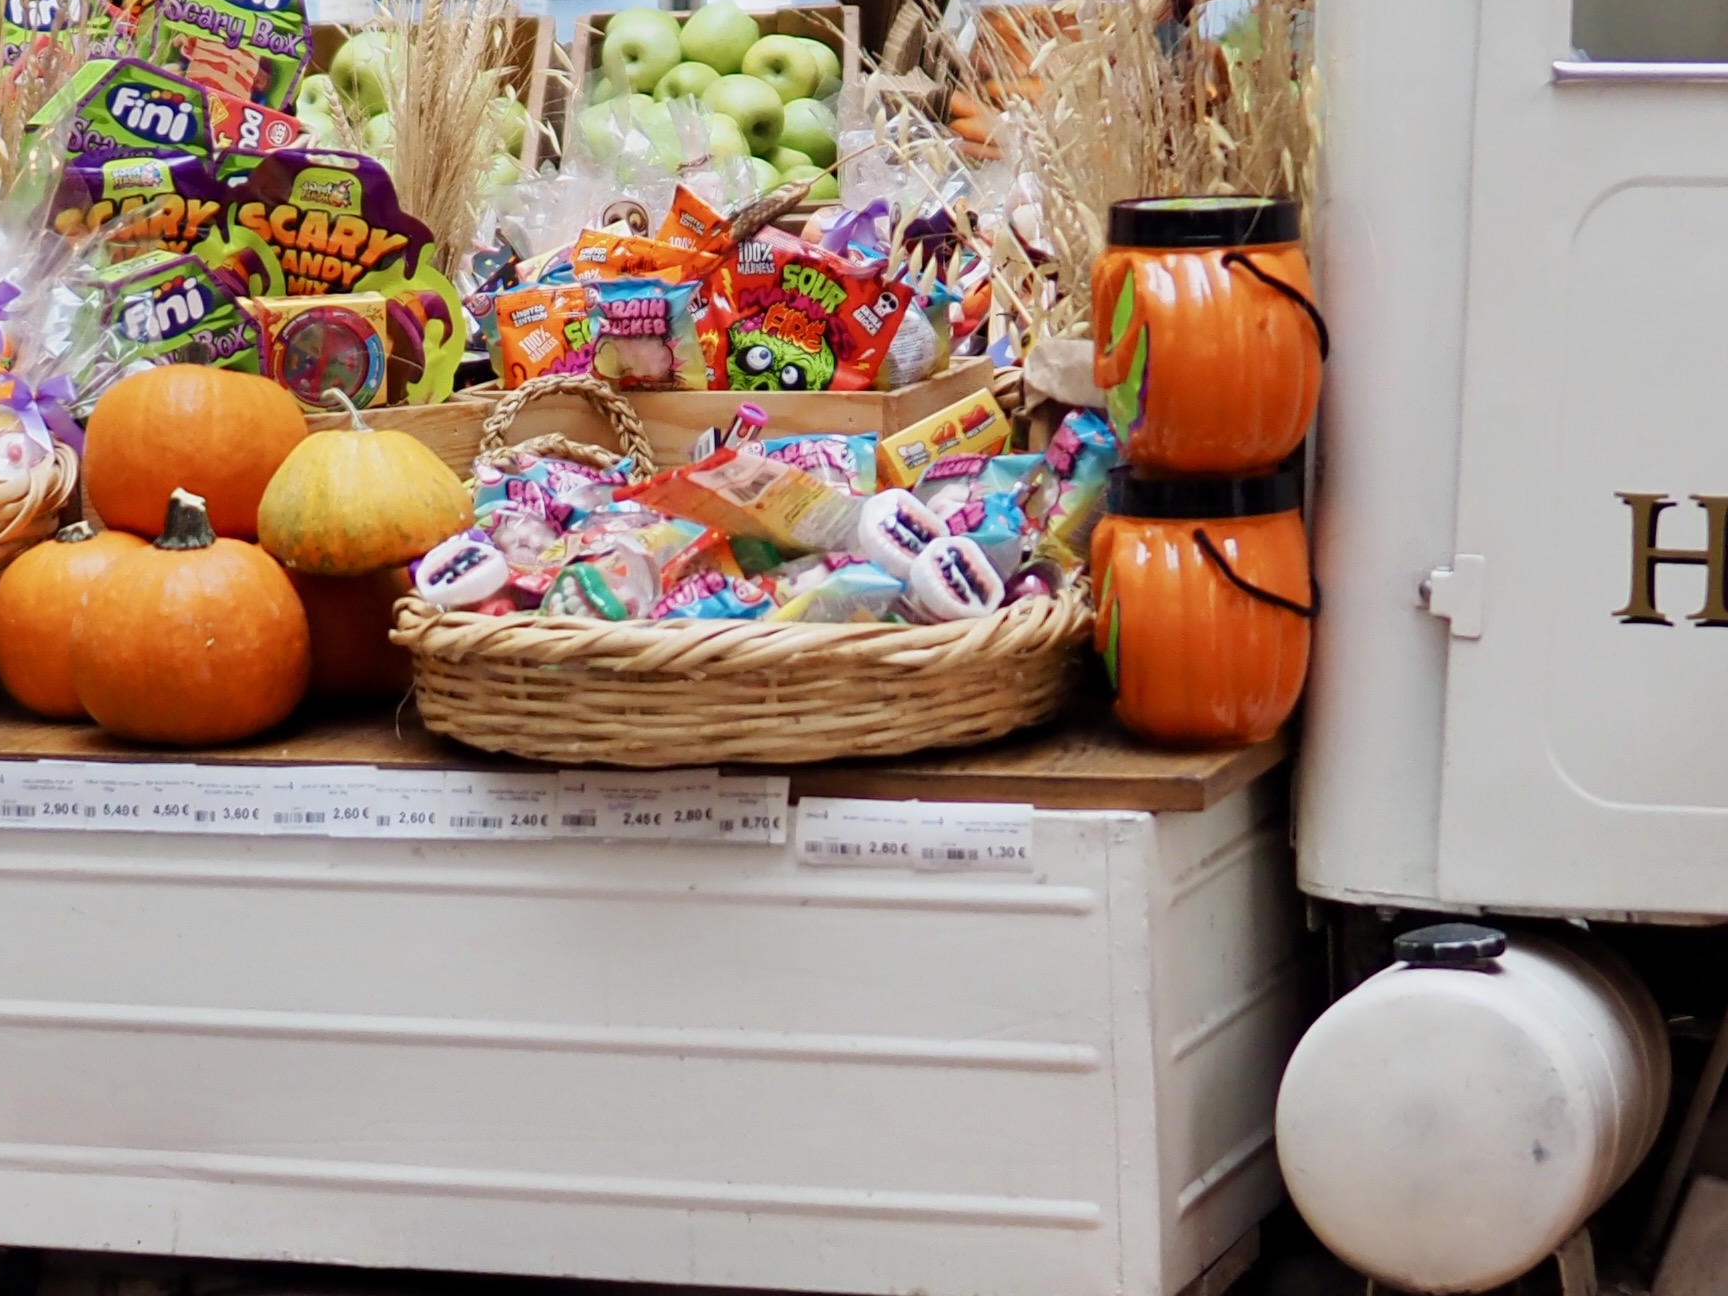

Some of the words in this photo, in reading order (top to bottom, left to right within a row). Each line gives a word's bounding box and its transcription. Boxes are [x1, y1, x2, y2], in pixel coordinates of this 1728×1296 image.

[250, 16, 305, 57] Box
[111, 87, 193, 142] Fini
[239, 202, 409, 267] SCARY
[737, 242, 774, 264] 100%
[736, 260, 776, 274] MADNESS
[782, 264, 848, 314] SOUR
[124, 276, 205, 339] Fini
